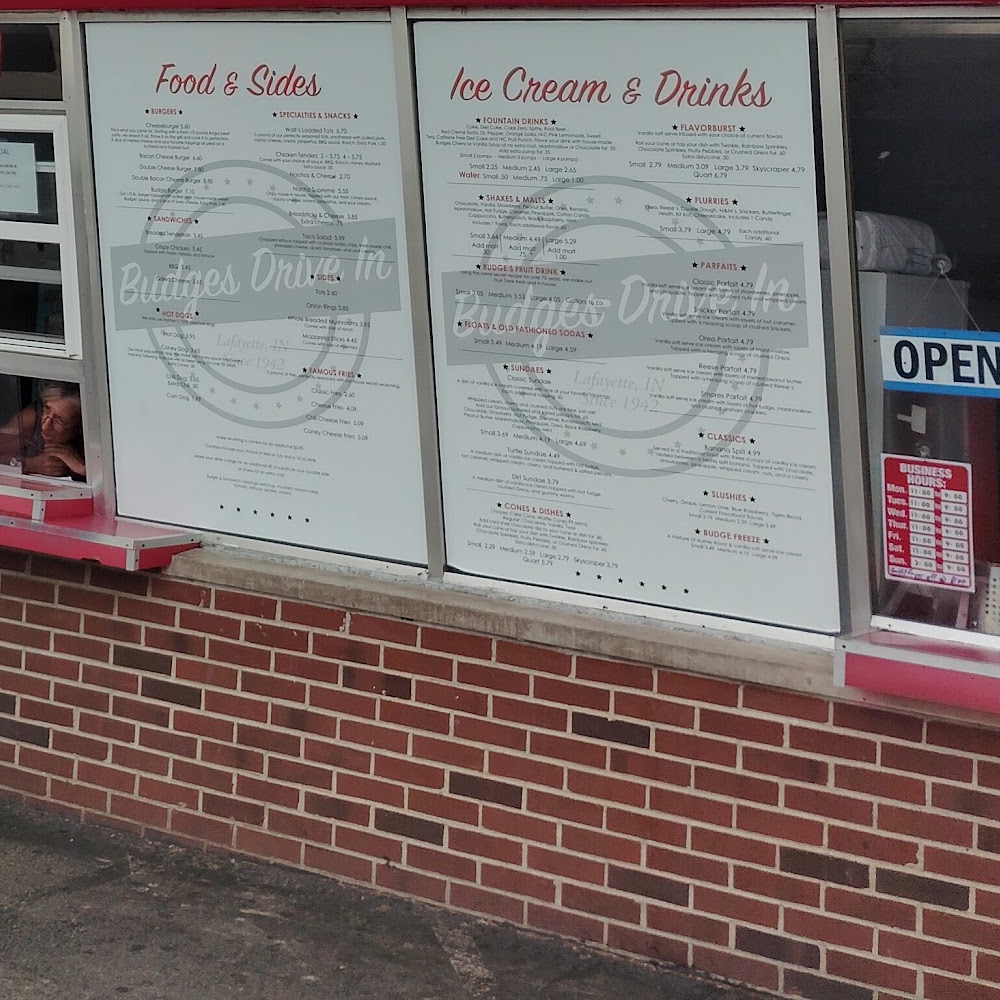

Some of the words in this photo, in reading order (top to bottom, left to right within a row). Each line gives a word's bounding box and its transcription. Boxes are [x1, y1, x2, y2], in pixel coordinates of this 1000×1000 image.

[155, 63, 217, 95] Food
[223, 72, 239, 96] &
[246, 64, 322, 97] Sides
[450, 66, 493, 101] Ice
[502, 66, 611, 104] Cream
[622, 77, 643, 106] &
[654, 68, 773, 107] Drinks
[680, 124, 736, 132] FLAVORBURST
[752, 165, 790, 173] Skyscraper
[523, 196, 545, 204] MALTS
[695, 197, 729, 205] FLURRIES
[154, 216, 192, 224] SANDWICHES
[516, 265, 534, 273] FRUIT
[536, 267, 558, 275] DRINK
[700, 262, 737, 271] PARFAITS
[119, 256, 241, 313] Budges
[250, 248, 344, 292] Drive
[355, 235, 392, 281] In
[453, 285, 610, 357] Budges
[617, 274, 737, 329] Drive
[750, 262, 798, 313] In
[465, 321, 490, 329] FLOATS
[516, 326, 557, 336] FASHIONED
[559, 329, 585, 338] SODAS
[256, 357, 285, 370] 1942
[893, 340, 1000, 385] OPEN
[309, 367, 336, 376] FAMOUS
[338, 369, 355, 377] FRIES
[511, 365, 544, 374] SUNDAES
[573, 370, 637, 391] Lafayette,
[644, 377, 666, 392] IN
[707, 433, 746, 444] CLASSICS
[899, 463, 953, 479] BUSINESS
[907, 474, 947, 488] HOURS:
[886, 483, 907, 494] Mon.
[712, 490, 746, 502] SLUSHIES
[504, 503, 530, 512] CONES
[539, 508, 563, 517] DISHES
[703, 529, 731, 540] BUDGE
[733, 533, 760, 543] FREEZE
